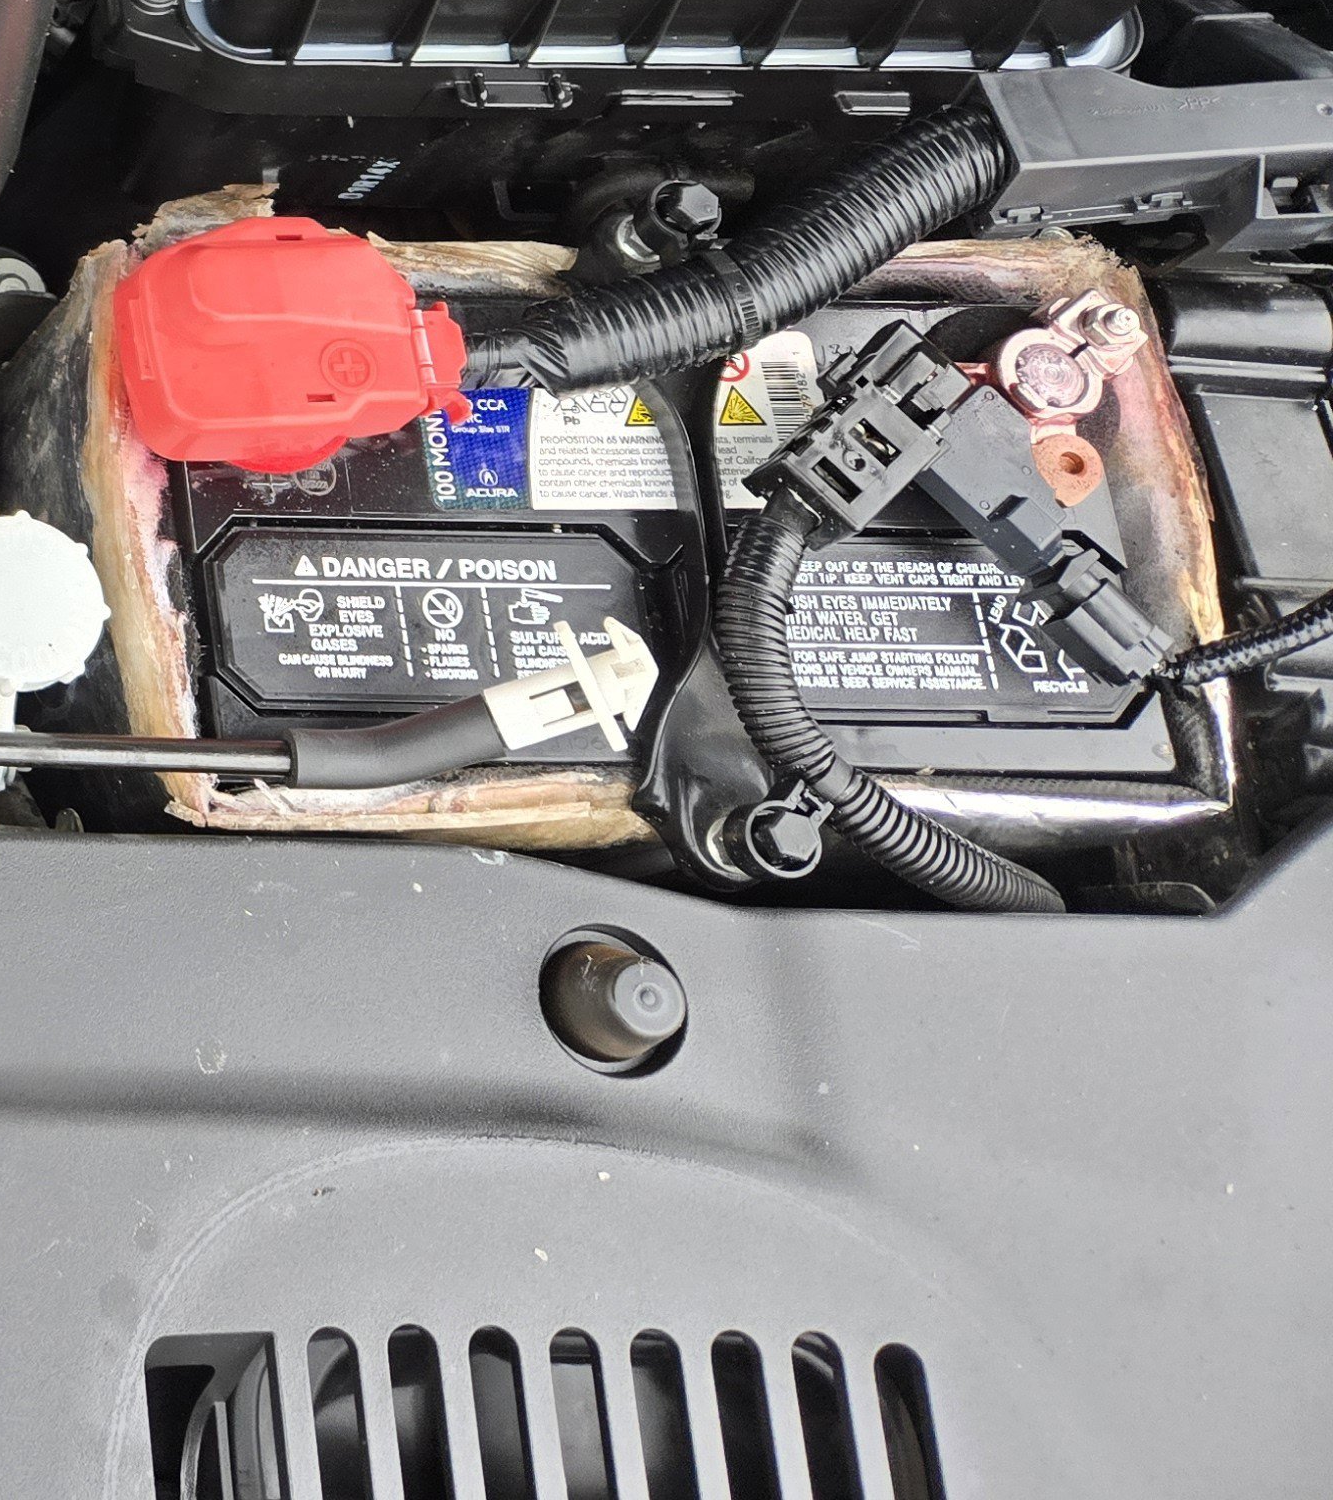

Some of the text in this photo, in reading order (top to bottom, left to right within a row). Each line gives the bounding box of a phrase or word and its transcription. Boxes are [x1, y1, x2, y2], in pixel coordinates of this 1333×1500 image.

[476, 398, 508, 411] CCA
[563, 415, 581, 426] Pb
[540, 435, 604, 445] PROPOSITION
[436, 470, 458, 502] 100
[465, 487, 519, 499] ACURA
[322, 556, 432, 580] DANGER
[458, 559, 558, 582] POISON
[825, 561, 850, 574] OUT
[851, 561, 869, 574] OF
[870, 561, 895, 574] THE
[897, 561, 935, 575] REACH
[937, 562, 954, 575] OF
[844, 573, 874, 585] KEEP
[876, 574, 905, 586] VENT
[907, 574, 939, 587] CAPS
[943, 574, 976, 587] TIGHT
[978, 575, 1002, 587] AND
[335, 595, 386, 609] SHIELD
[822, 596, 859, 611] EYES
[861, 596, 952, 612] IMMEDIATELY
[338, 609, 375, 623] EYES
[987, 594, 1008, 625] LEAD
[870, 612, 899, 627] GET
[308, 623, 384, 638] EXPLOSIVE
[434, 628, 457, 642] NO
[844, 627, 881, 642] HELP
[883, 628, 918, 643] FAST
[310, 638, 359, 652] GASES
[579, 631, 611, 645] ACID
[511, 645, 569, 658] CAN CAUS
[793, 651, 980, 666] FOR SAFE JUMP STARTING FOLLOW
[278, 652, 394, 667] CAN CAUSE BLINDNESS
[313, 666, 367, 679] OR INJURY
[825, 665, 839, 676] IN
[840, 665, 884, 677] VEHICLE
[885, 666, 933, 678] OWNERS
[842, 676, 871, 689] SEEK
[872, 676, 918, 690] SERVICE
[1032, 680, 1090, 694] RECYCLE
